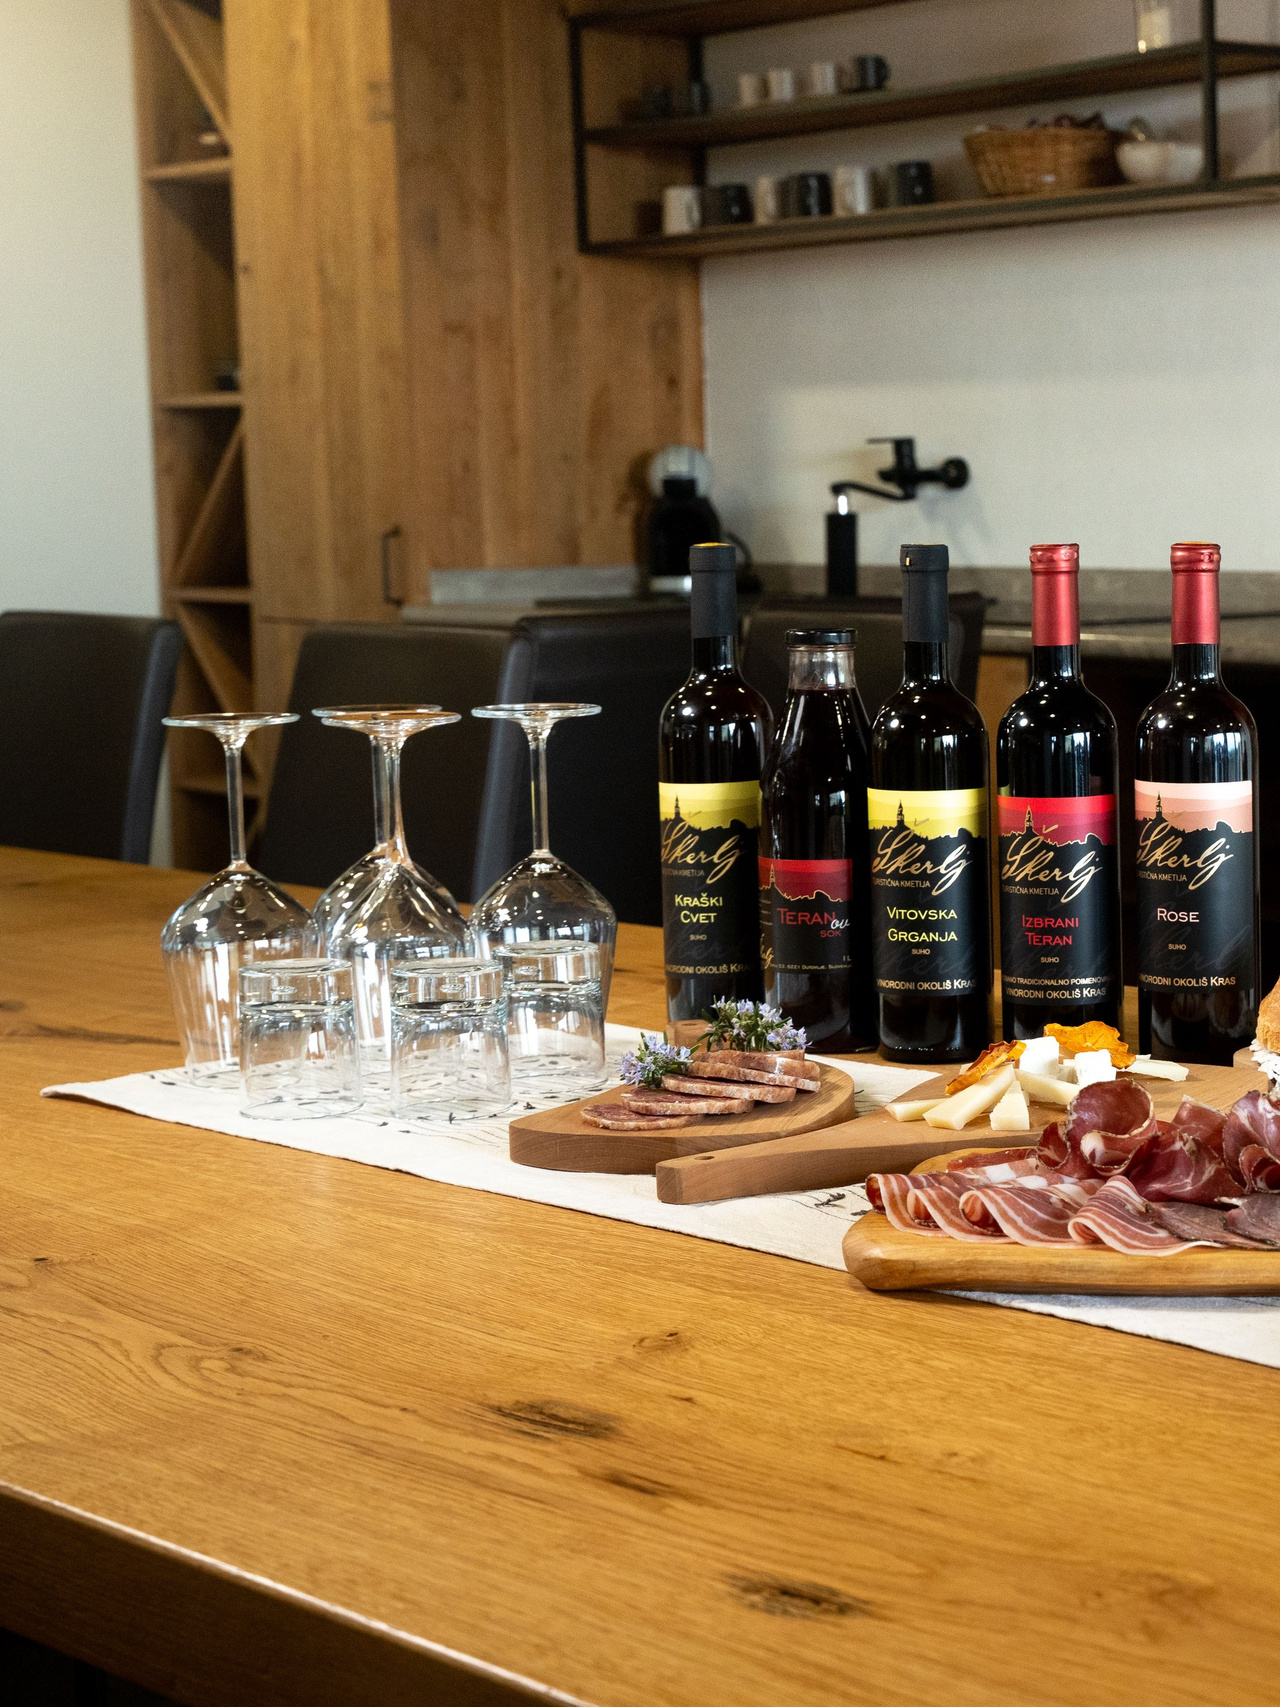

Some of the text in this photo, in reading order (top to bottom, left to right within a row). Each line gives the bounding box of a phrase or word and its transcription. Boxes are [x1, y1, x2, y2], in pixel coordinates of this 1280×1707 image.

[1158, 873, 1187, 882] KMETIJA
[900, 880, 931, 888] KMETIJA
[1029, 887, 1060, 895] KMETIJA
[675, 892, 723, 907] KRAŠKI
[680, 912, 717, 924] CVET
[886, 906, 958, 920] VITOVSKA
[1157, 908, 1200, 922] ROSE
[1022, 914, 1079, 928] IZBRANI
[820, 929, 842, 938] SOK
[887, 928, 958, 942] GRGANJA
[1025, 932, 1073, 946] TERAN
[695, 964, 728, 974] OKOLIŠ
[917, 980, 952, 990] OKOLIŠ
[1017, 977, 1069, 986] TRADICIONALNO
[1173, 976, 1208, 987] OKOLIŠ
[1210, 975, 1236, 986] KRAS
[1046, 988, 1081, 999] OKOLIŠ
[1083, 987, 1107, 998] KRAS
